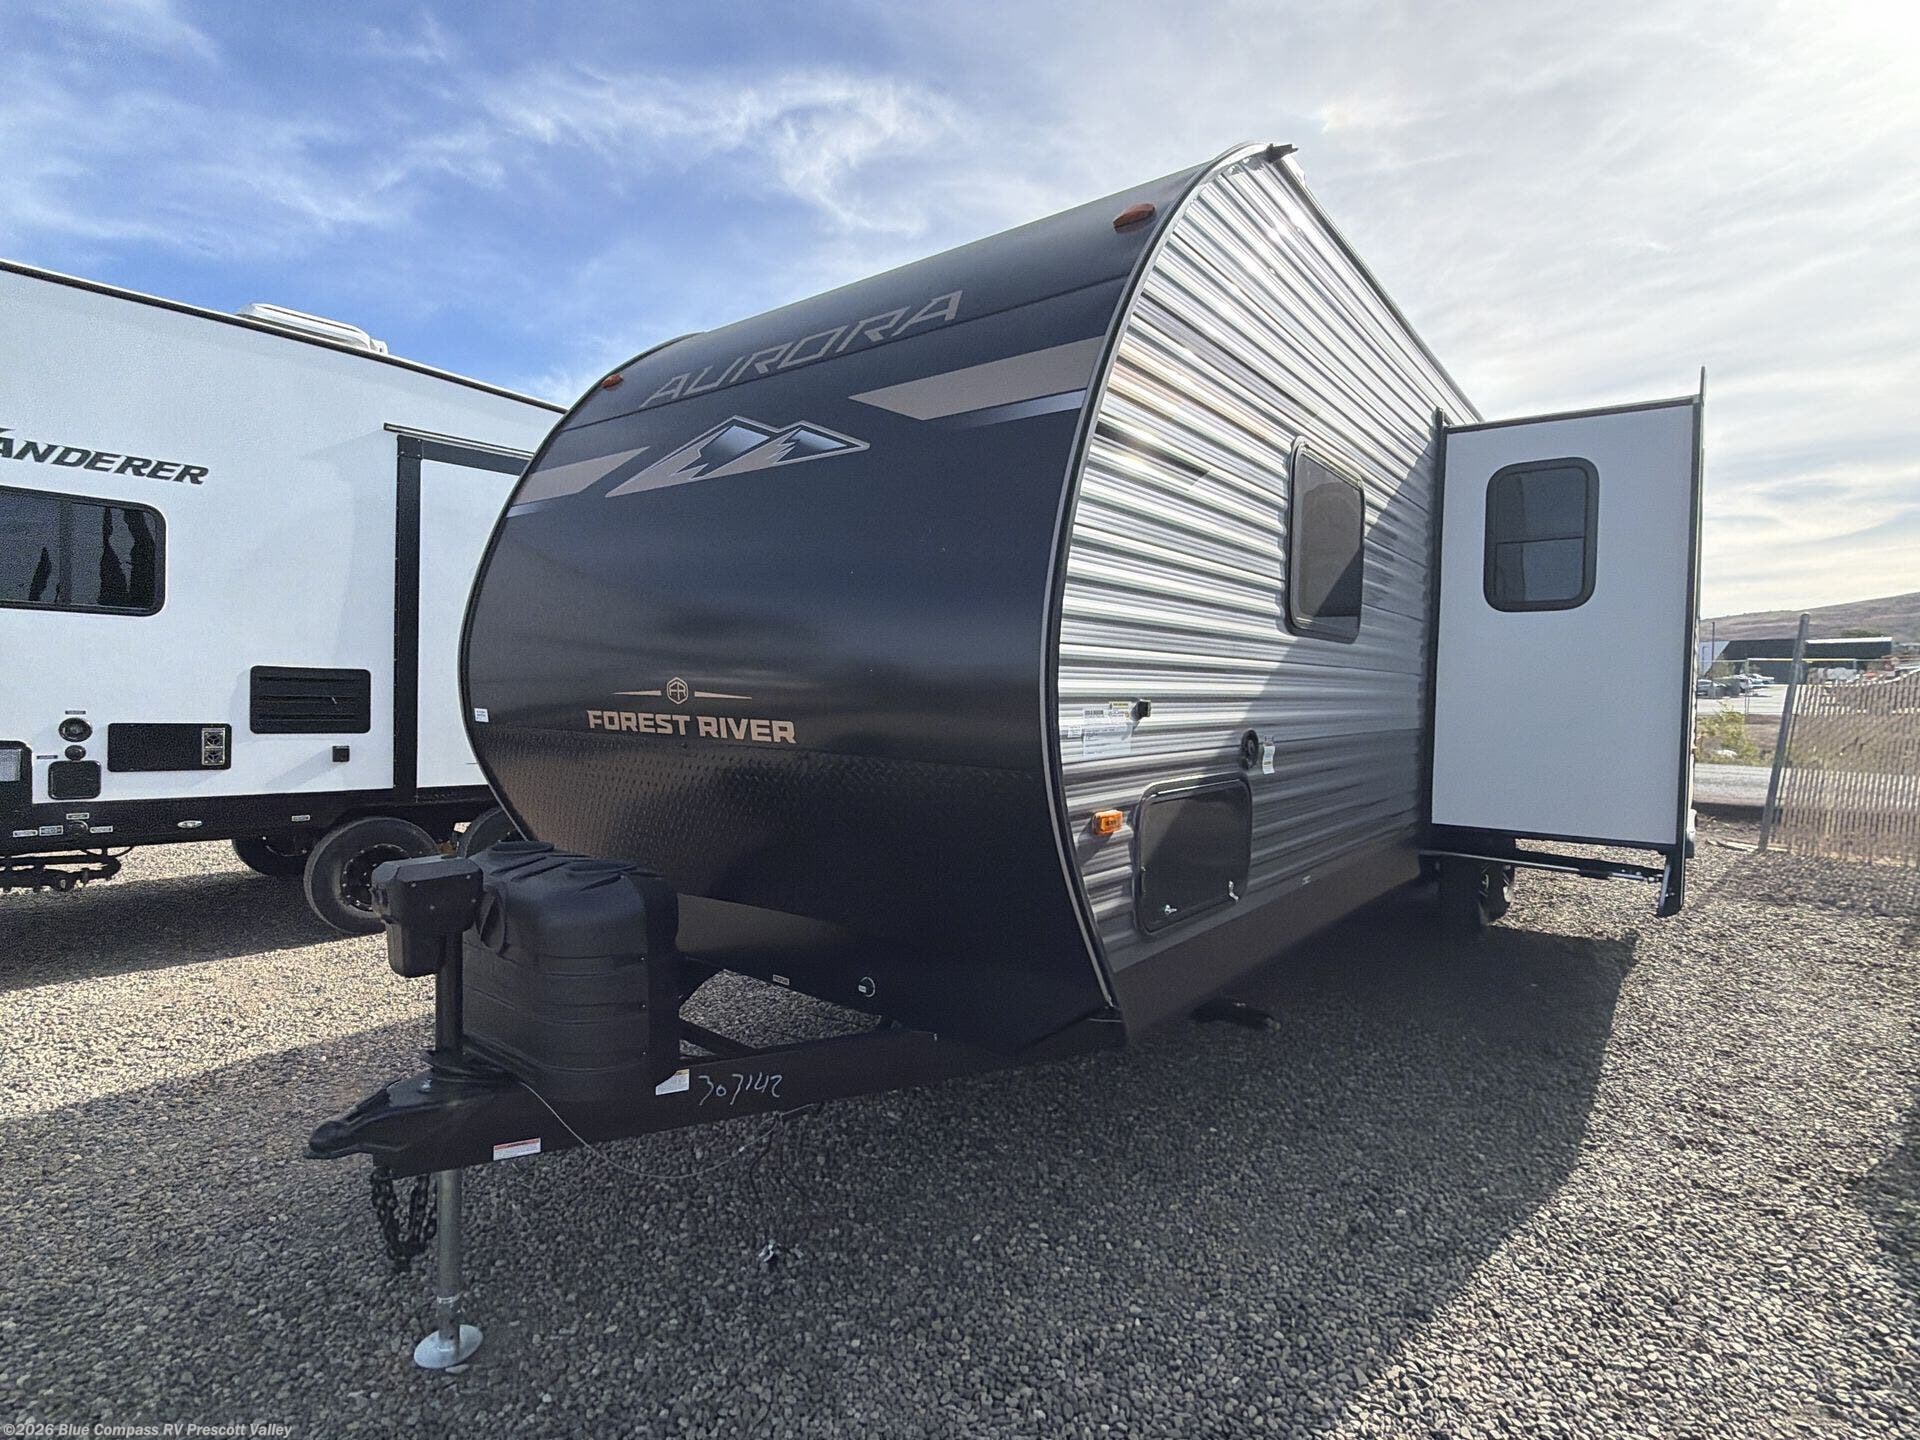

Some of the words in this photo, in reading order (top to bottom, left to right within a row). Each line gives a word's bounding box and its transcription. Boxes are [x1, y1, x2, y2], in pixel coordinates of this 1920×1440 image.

[639, 290, 963, 409] AURORA
[0, 427, 209, 485] ANDERER
[587, 710, 690, 736] FOREST
[697, 715, 797, 744] RIVER
[698, 1072, 783, 1106] 307142
